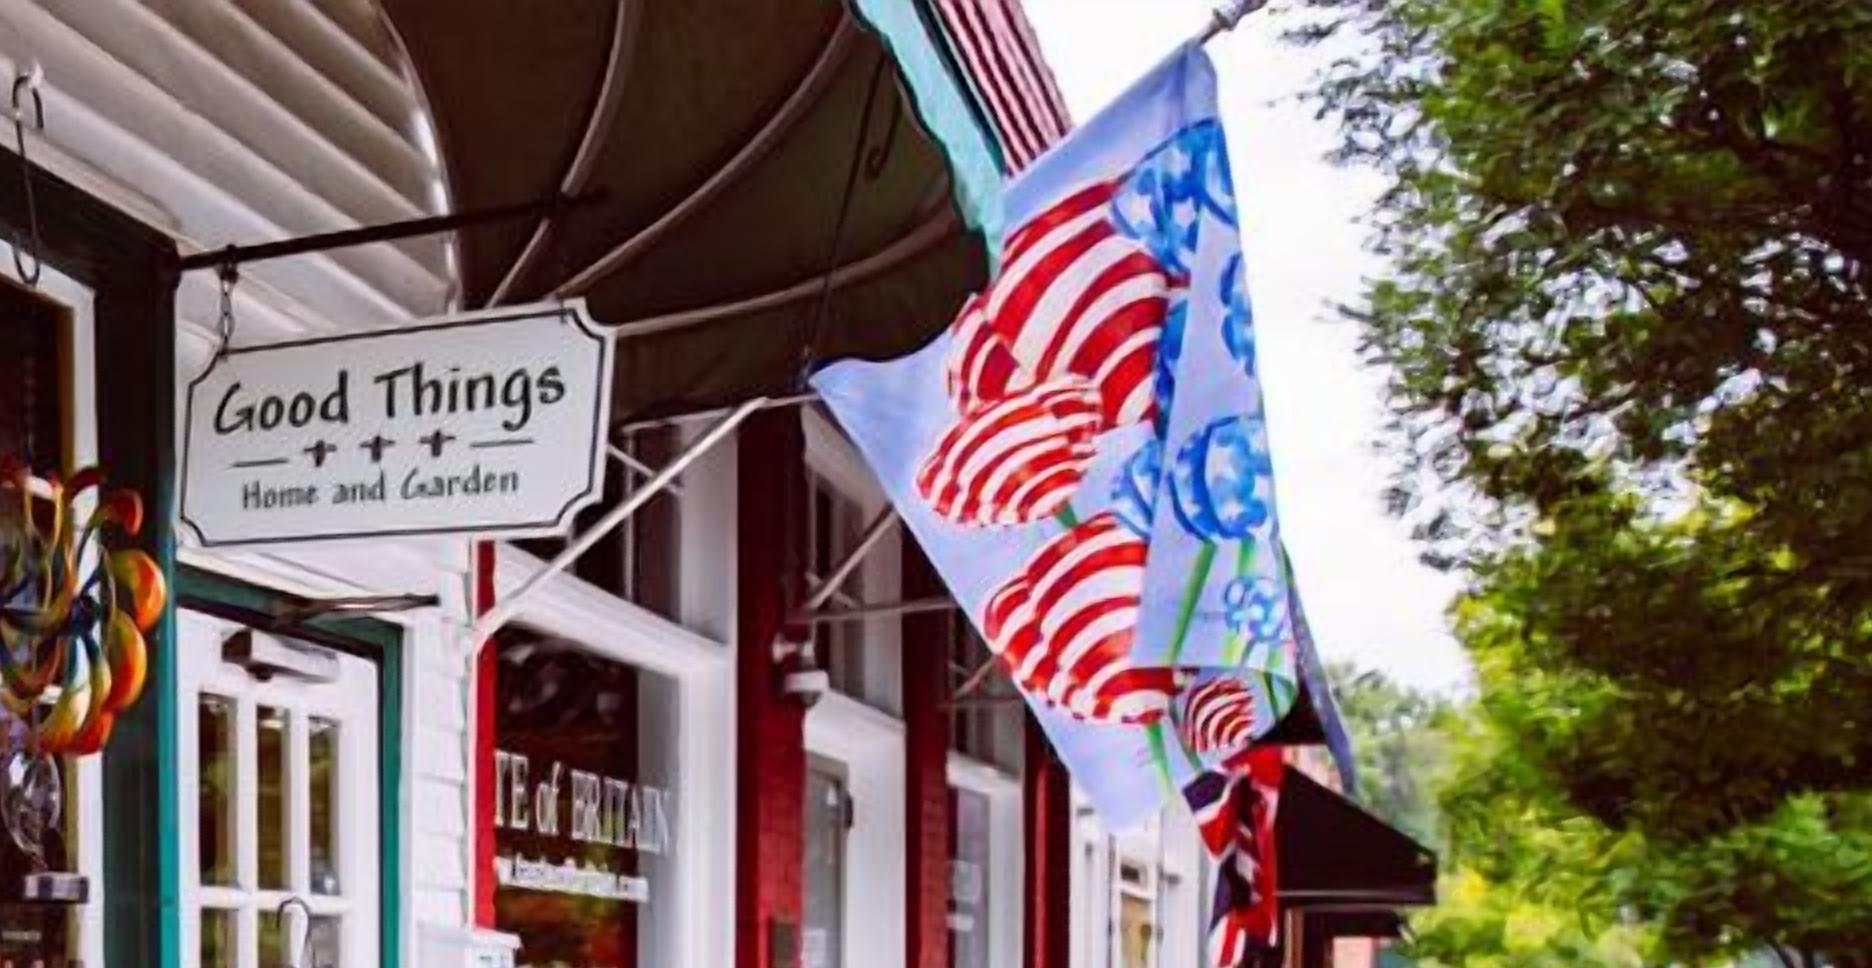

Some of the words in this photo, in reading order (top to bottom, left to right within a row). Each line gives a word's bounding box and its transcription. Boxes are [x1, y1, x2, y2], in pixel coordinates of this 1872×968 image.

[214, 368, 349, 435] Good
[374, 361, 565, 432] Things
[242, 481, 319, 511] Home
[332, 468, 387, 504] and
[400, 464, 519, 501] Garden
